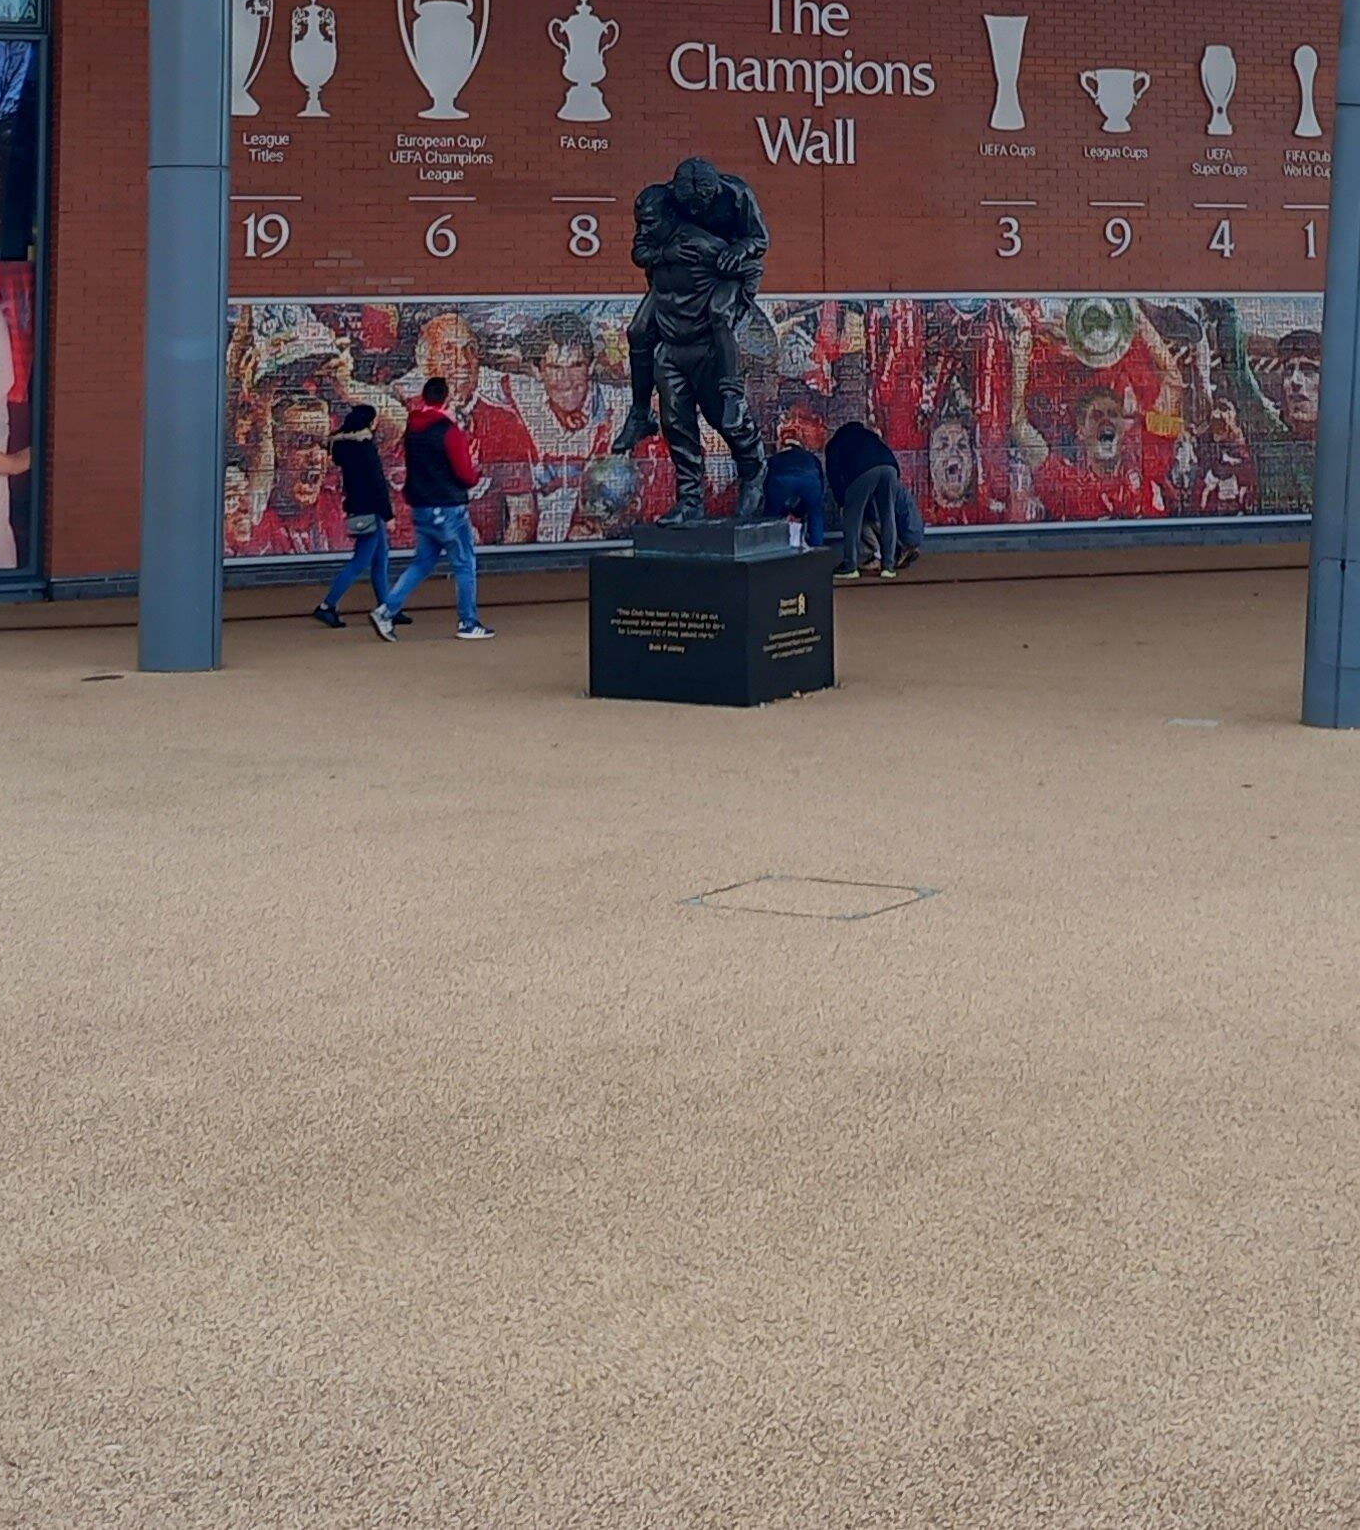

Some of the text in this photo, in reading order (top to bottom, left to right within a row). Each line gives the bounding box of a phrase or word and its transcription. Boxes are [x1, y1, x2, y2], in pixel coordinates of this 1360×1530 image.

[669, 41, 936, 107] Champions
[243, 132, 291, 148] League
[396, 133, 488, 152] European Cup/
[560, 136, 609, 152] FA Cups
[754, 116, 856, 166] Wall
[248, 148, 284, 163] Titles
[389, 150, 494, 168] UEFA Champions
[979, 143, 1036, 159] UEFA Cups
[1084, 145, 1148, 161] League Cups
[1206, 147, 1233, 161] UEFA
[1285, 149, 1332, 163] FIFA Club
[419, 167, 465, 184] League
[1192, 162, 1248, 177] Super Cups
[1283, 163, 1312, 177] World
[242, 212, 291, 259] 19
[425, 213, 458, 258] 6
[569, 213, 601, 257] 8
[996, 216, 1023, 258] 3
[1104, 217, 1132, 258] 9
[1208, 219, 1236, 259] 4
[1304, 219, 1318, 259] 1
